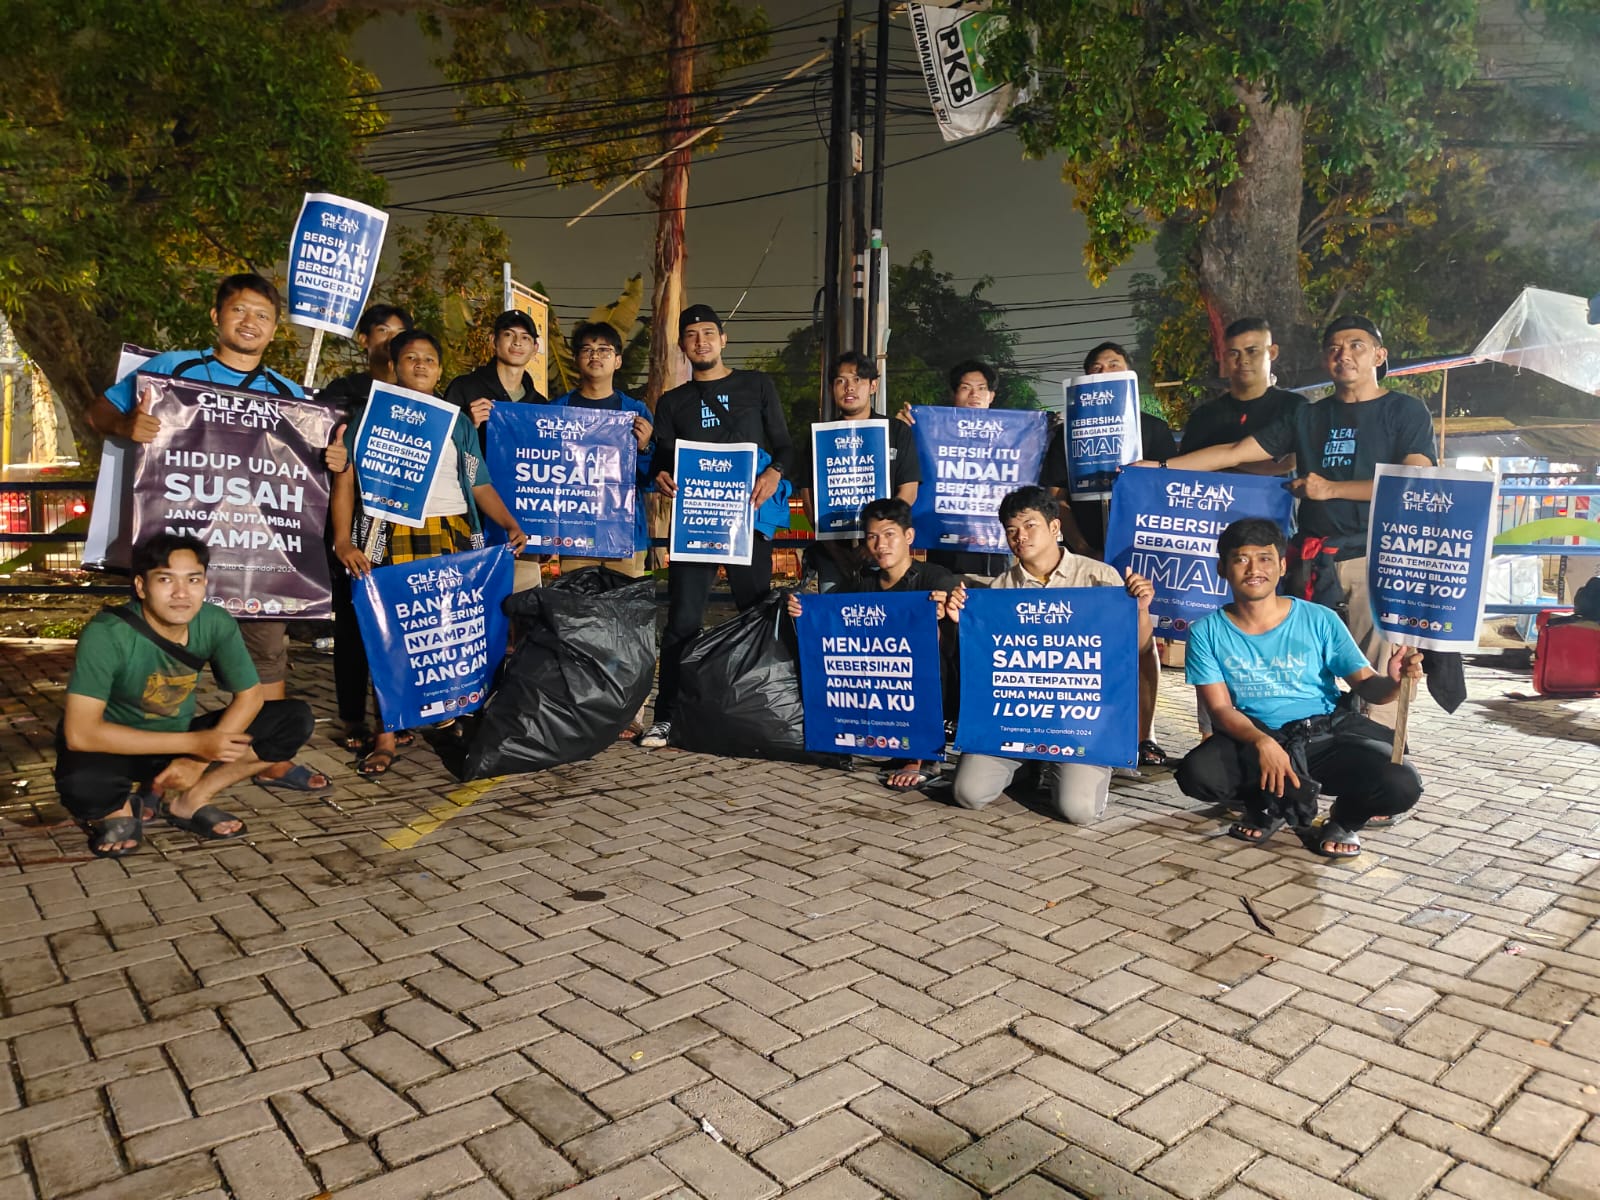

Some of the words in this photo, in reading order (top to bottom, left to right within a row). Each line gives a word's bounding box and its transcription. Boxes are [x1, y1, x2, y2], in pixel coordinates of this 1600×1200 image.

[939, 26, 974, 103] PKB
[321, 211, 360, 231] CLEAN
[321, 220, 337, 231] THE
[339, 223, 359, 235] CITY
[303, 231, 348, 249] BERSIH
[350, 242, 371, 257] ITU
[300, 243, 368, 275] INDAH
[297, 260, 342, 280] BERSIH
[345, 271, 364, 287] ITU
[296, 275, 360, 298] ANUGERAH
[1080, 389, 1115, 401] CLEAN
[1095, 398, 1113, 406] CITY
[197, 392, 283, 420] CLEAN
[391, 404, 427, 421] CLEAN
[200, 407, 236, 425] THE
[240, 413, 282, 432] CITY
[406, 415, 426, 427] CITY
[536, 416, 587, 432] CLEAN
[957, 418, 1004, 431] CLEAN
[1071, 415, 1125, 427] KEBERSIHA
[371, 425, 432, 451] MENJAGA
[537, 428, 558, 439] THE
[561, 431, 587, 441] CITY
[834, 435, 864, 445] CLEAN
[958, 429, 978, 438] THE
[979, 430, 1003, 440] CITY
[1072, 427, 1107, 437] SEBAGIAN
[370, 440, 428, 462] KEBERSIHAN
[516, 448, 561, 460] HIDUP
[938, 445, 992, 459] BERSIH
[995, 448, 1020, 460] ITU
[165, 449, 241, 470] HIDUP
[249, 457, 308, 481] UDAH
[365, 450, 400, 465] ADALAH
[400, 459, 426, 472] JALAN
[699, 457, 733, 468] CLEAN
[826, 454, 875, 467] BANYAK
[361, 458, 401, 478] NINJA
[404, 470, 424, 483] KU
[515, 462, 605, 486] SUSAH
[827, 466, 847, 474] YANG
[848, 465, 874, 473] SERING
[937, 460, 1019, 482] INDAH
[685, 478, 710, 487] YANG
[713, 481, 746, 489] BUANG
[829, 476, 873, 485] NYAMPAH
[164, 473, 305, 513] SUSAH
[515, 485, 554, 495] JANGAN
[555, 487, 602, 498] DITAMBAH
[684, 486, 745, 500] SAMPAH
[828, 487, 854, 497] KAMU
[856, 486, 876, 495] MAH
[1165, 479, 1235, 501] CLEAN
[1402, 488, 1454, 505] CLEAN
[516, 497, 602, 515] NYAMPAH
[828, 495, 876, 507] JANGAN
[937, 500, 1001, 513] ANUGERA
[1166, 495, 1194, 509] THE
[1197, 497, 1233, 512] CITY
[1403, 501, 1424, 512] THE
[1426, 502, 1454, 514] CITY
[164, 509, 230, 522] JANGAN
[233, 512, 301, 529] DITAMBAH
[683, 516, 688, 524] I
[689, 517, 719, 526] LOVE
[1382, 521, 1417, 535] YANG
[1422, 526, 1473, 541] BUANG
[1136, 535, 1212, 553] SEBAGIAN
[1380, 535, 1471, 559] SAMPAH
[1380, 554, 1404, 565] PADA
[1406, 557, 1467, 572] TEMPATNYA
[407, 565, 464, 586] CLEAN
[1378, 566, 1402, 577] CUMA
[1405, 569, 1427, 579] MAU
[1428, 572, 1467, 585] BILANG
[410, 581, 434, 595] THE
[1376, 576, 1383, 588] I
[1385, 578, 1426, 594] LOVE
[1430, 584, 1466, 599] YOU
[395, 587, 485, 619] BANYAK
[841, 603, 887, 618] CLEAN
[1016, 600, 1074, 615] CLEAN
[400, 615, 438, 631] YANG
[441, 604, 485, 624] ERING
[842, 616, 862, 627] THE
[864, 616, 887, 627] CITY
[1017, 613, 1041, 624] THE
[1044, 613, 1073, 624] CITY
[407, 620, 484, 650] NYAMPAH
[992, 634, 1038, 647] YANG
[1043, 634, 1102, 648] BUANG
[410, 648, 457, 669] KAMU
[461, 637, 488, 657] MAH
[822, 637, 912, 653] MENJAGA
[827, 660, 910, 673] KEBERSIHAN
[993, 650, 1101, 670] SAMPAH
[415, 652, 488, 687] JANGAN
[1263, 669, 1304, 682] CITY
[826, 677, 872, 689] ADALAH
[874, 679, 912, 691] JALAN
[994, 675, 1025, 684] PADA
[1028, 675, 1099, 686] TEMPATNYA
[826, 691, 883, 710] NINJA
[887, 694, 915, 712] KU
[993, 689, 1025, 699] CUMA
[1028, 690, 1054, 700] MAU
[1056, 691, 1101, 702] BILANG
[992, 702, 1000, 716] I
[1003, 703, 1055, 719] LOVE
[1060, 705, 1101, 721] YOU
